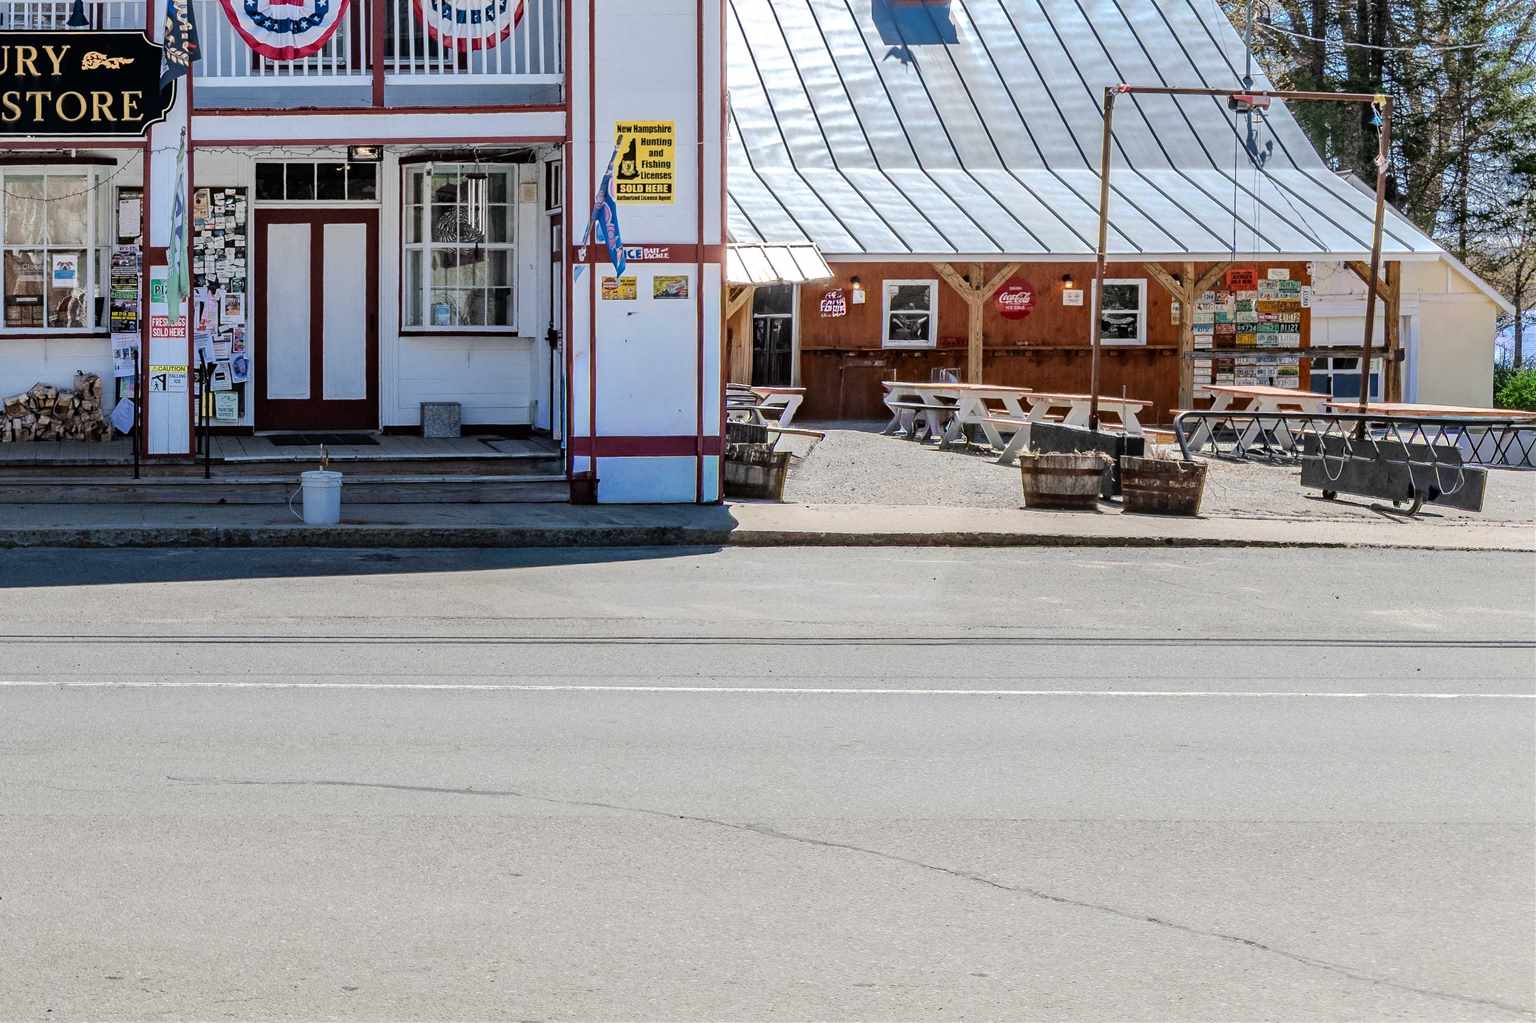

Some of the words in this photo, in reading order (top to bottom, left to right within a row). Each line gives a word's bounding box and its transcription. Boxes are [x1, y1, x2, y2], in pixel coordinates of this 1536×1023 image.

[1, 91, 144, 123] STORE
[617, 124, 632, 133] New
[633, 124, 672, 134] Hampshire
[640, 137, 672, 147] Hunting
[648, 149, 664, 157] and
[641, 160, 671, 169] Fishing
[640, 172, 672, 180] Licenses
[620, 184, 644, 193] SOLD
[645, 184, 669, 193] HERE
[998, 292, 1031, 304] Coca-Cola
[152, 328, 169, 336] SOLD
[169, 328, 185, 336] HERE
